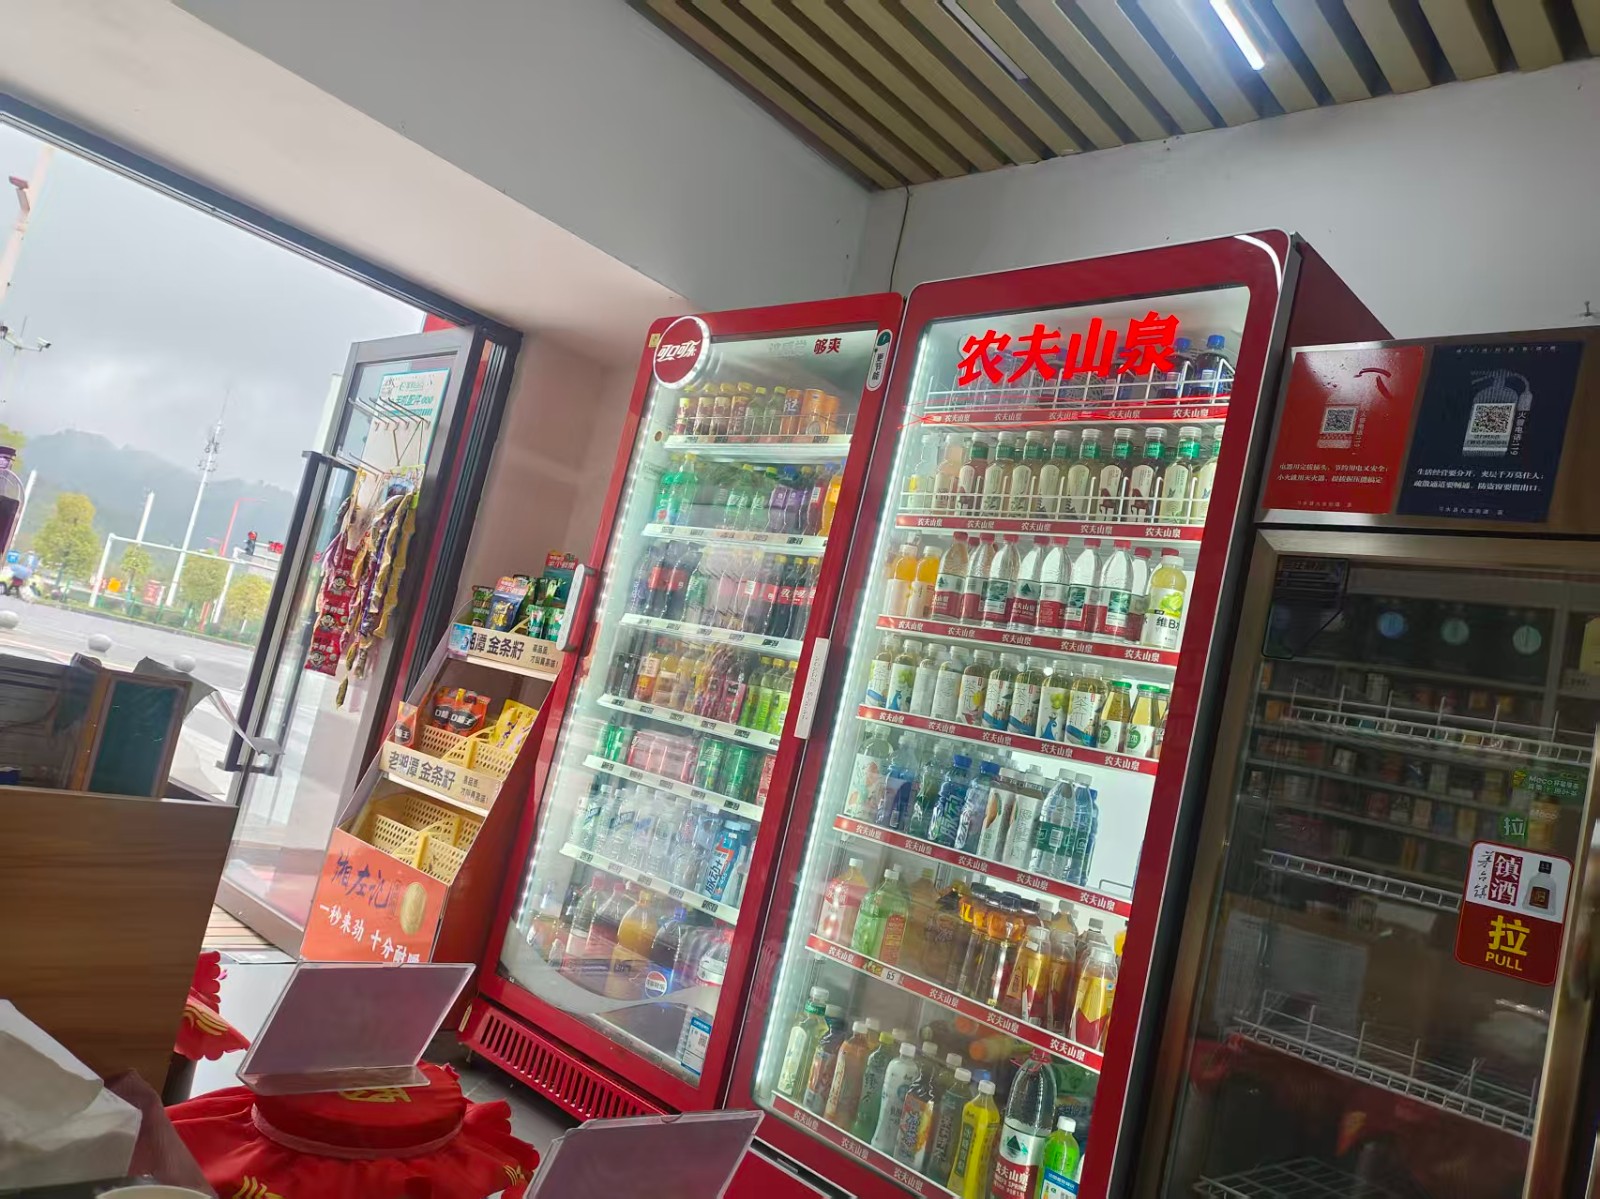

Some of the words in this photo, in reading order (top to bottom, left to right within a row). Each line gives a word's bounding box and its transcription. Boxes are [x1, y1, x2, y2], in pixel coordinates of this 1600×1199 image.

[656, 339, 702, 362] 可口可乐
[813, 337, 843, 355] 够爽
[957, 311, 1180, 386] 农夫山泉
[1172, 407, 1209, 418] 农夫山泉
[1144, 527, 1181, 539] 农夫山泉
[1002, 632, 1033, 646] 农夫山泉
[1061, 640, 1094, 654] 农夫山泉
[1124, 649, 1160, 663] 农夫山泉
[982, 731, 1012, 746] 农夫山泉
[1041, 742, 1073, 758] 农夫山泉
[1104, 755, 1140, 772] 农夫山泉
[418, 760, 457, 791] 金条籽
[1503, 816, 1525, 838] 拉
[958, 855, 989, 873] 农夫山泉
[1016, 872, 1049, 892] 农夫山泉
[1079, 892, 1115, 912] 农夫山泉
[319, 904, 365, 942] 一秒来劲
[1488, 914, 1531, 957] 拉
[1485, 951, 1523, 972] PULL
[929, 988, 959, 1009] 农夫山泉
[986, 1012, 1019, 1034] 农夫山泉
[1049, 1038, 1086, 1063] 农夫山泉
[893, 1167, 924, 1193] 农夫山泉
